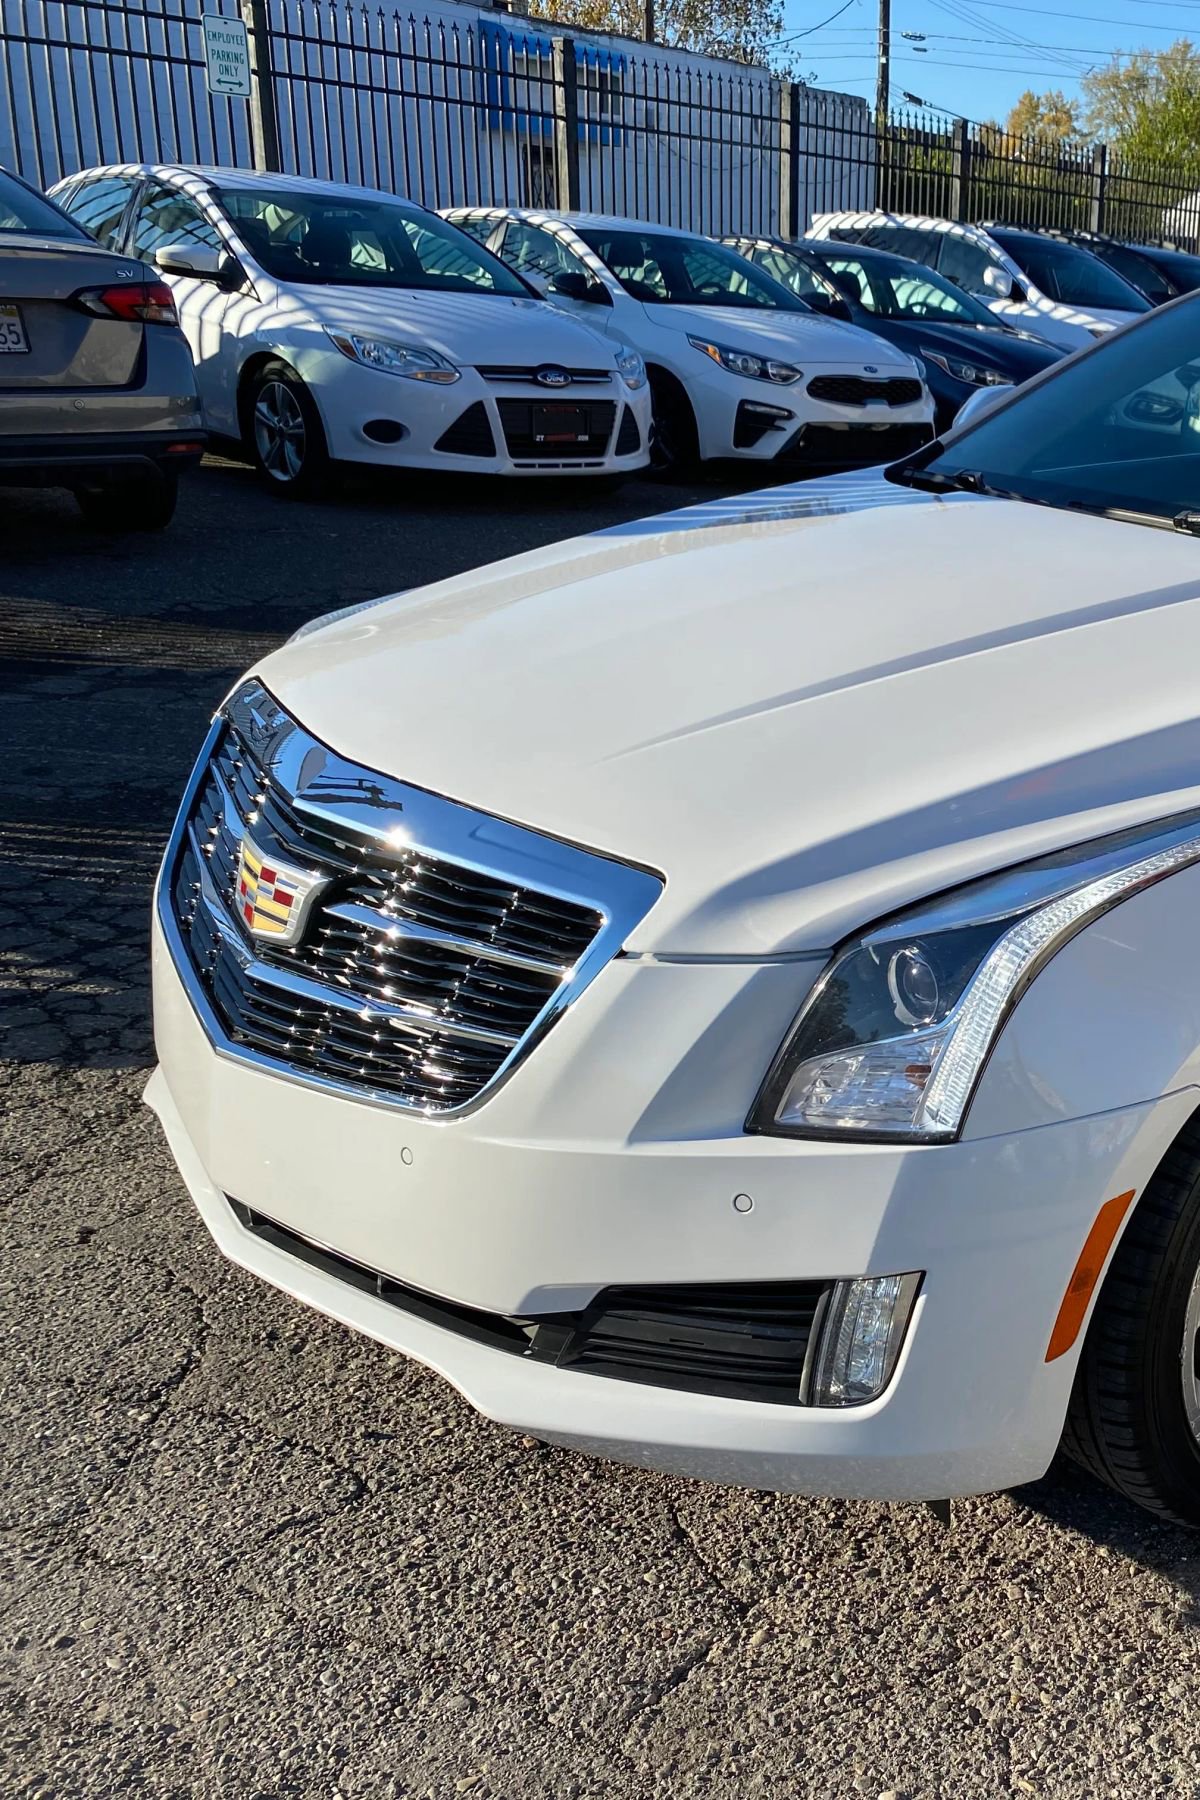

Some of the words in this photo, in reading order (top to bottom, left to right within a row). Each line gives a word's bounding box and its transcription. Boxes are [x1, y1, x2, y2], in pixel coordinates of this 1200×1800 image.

[207, 30, 244, 46] EMPLOYEE
[211, 48, 244, 65] PARKING
[218, 63, 239, 77] ONLY
[116, 269, 134, 278] SV
